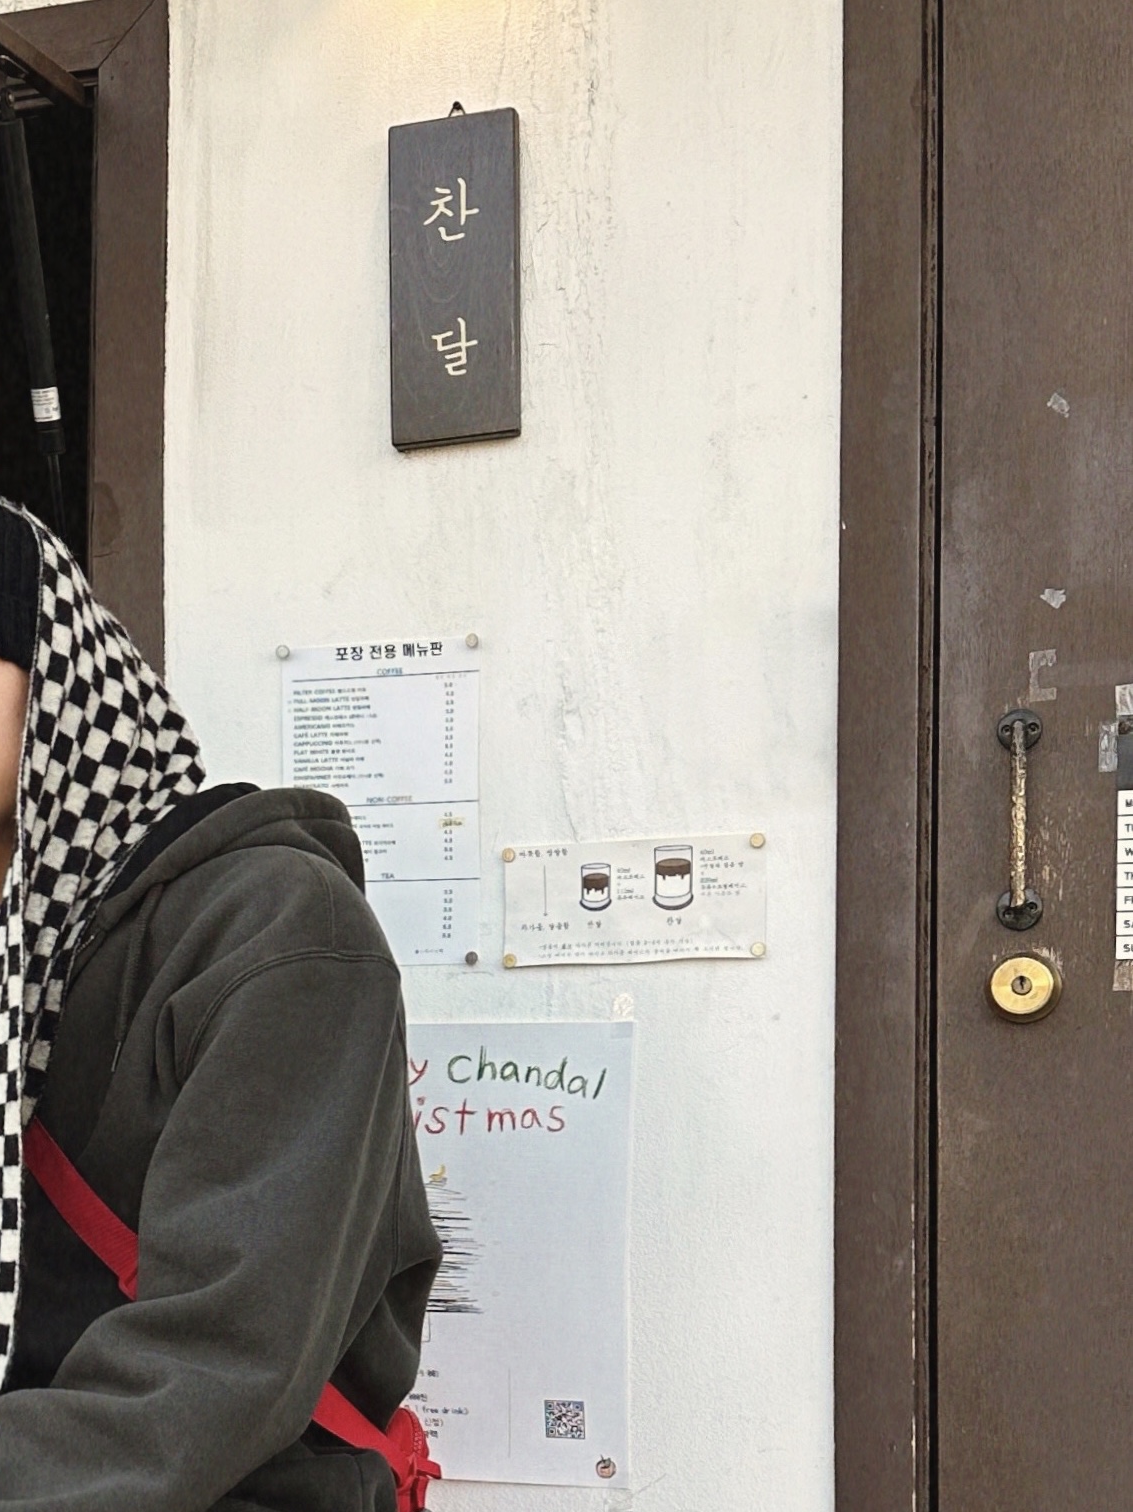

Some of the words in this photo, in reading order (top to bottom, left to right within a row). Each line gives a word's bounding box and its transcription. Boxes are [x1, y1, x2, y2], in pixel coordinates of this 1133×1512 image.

[335, 646, 364, 661] 포장
[369, 644, 397, 660] 전용
[402, 641, 444, 658] 메뉴판
[376, 668, 403, 676] COFFEE
